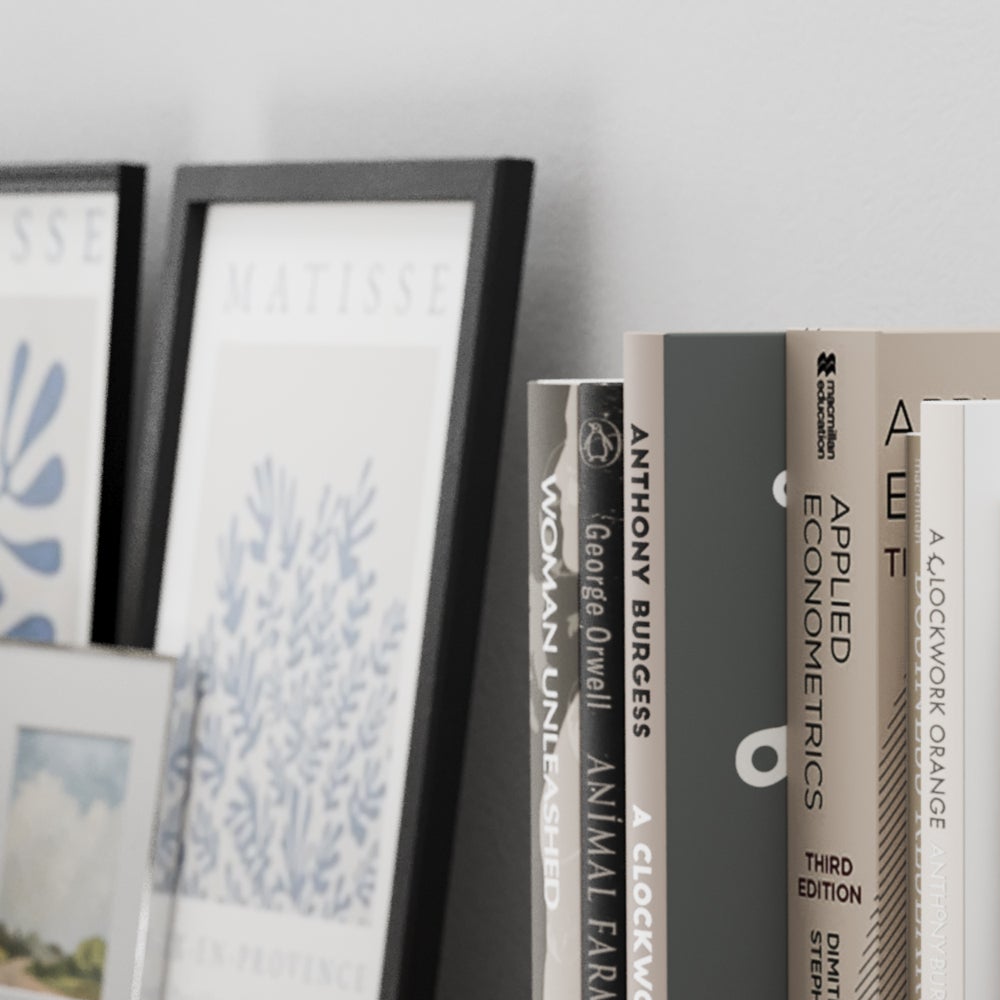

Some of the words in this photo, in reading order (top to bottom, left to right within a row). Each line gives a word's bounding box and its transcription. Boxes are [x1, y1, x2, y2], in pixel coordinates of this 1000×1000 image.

[221, 261, 454, 318] MATISSE
[816, 379, 826, 461] education
[825, 379, 837, 461] macmillan
[630, 423, 651, 585] ANTHONY
[928, 528, 945, 546] A
[539, 473, 559, 653] WOMAN
[580, 523, 612, 618] George
[829, 494, 852, 665] APPLIED
[585, 625, 612, 709] Orwell
[631, 599, 652, 739] BURGESS
[803, 493, 824, 811] ECONOMETRICS
[926, 551, 946, 715] CLOCKWORK
[541, 667, 560, 912] UNLEASHED
[632, 804, 653, 829] A
[929, 724, 946, 830] ORANGE
[798, 877, 863, 906] EDITION
[805, 852, 854, 877] THIRD
